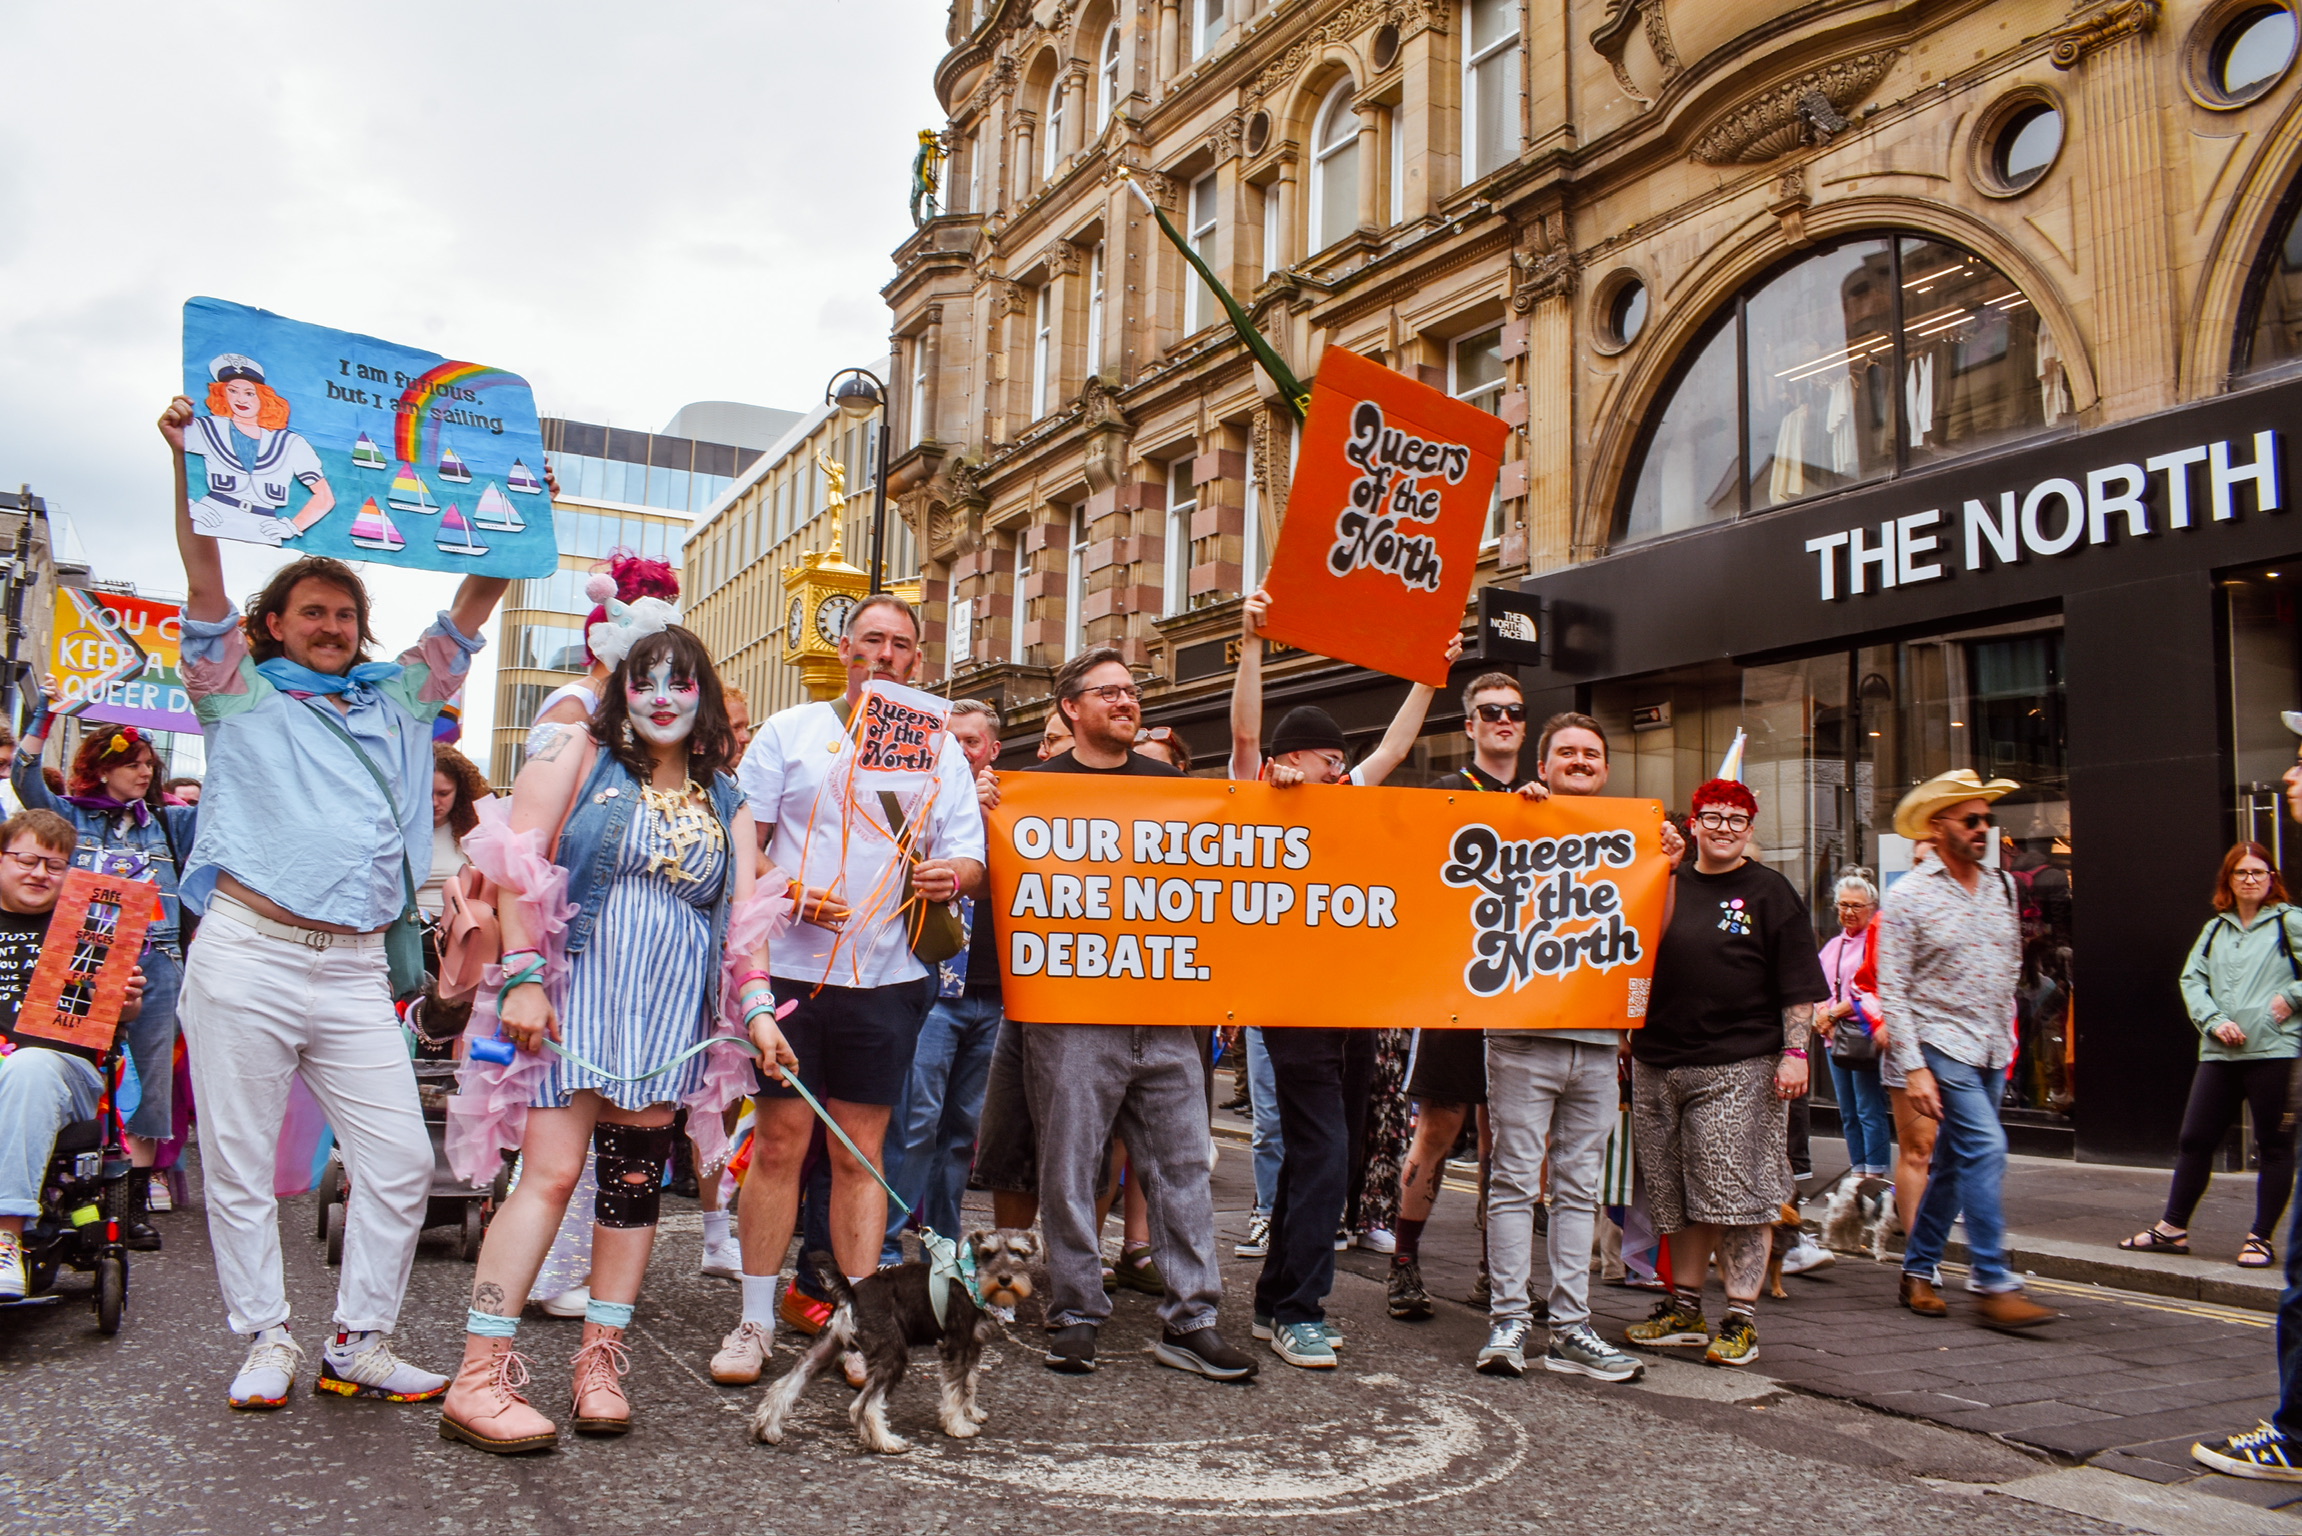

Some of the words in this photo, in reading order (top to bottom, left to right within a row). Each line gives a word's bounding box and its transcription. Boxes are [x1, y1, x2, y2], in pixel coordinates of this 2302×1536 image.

[339, 359, 350, 376] I
[357, 363, 388, 384] am
[325, 379, 369, 405] but
[373, 394, 383, 410] I
[390, 398, 422, 417] am
[430, 407, 504, 435] sailing
[1346, 402, 1470, 485] Queers
[1351, 466, 1393, 514] of
[1392, 478, 1440, 520] the
[1805, 508, 1946, 601] THE
[1963, 429, 2282, 571] NORTH
[1331, 509, 1441, 590] North
[73, 600, 148, 636] YOU
[1490, 618, 1521, 631] NORTH
[1498, 628, 1522, 640] FACE
[1503, 610, 1521, 622] THE
[59, 637, 136, 673] KEEP
[142, 652, 165, 679] A
[62, 674, 159, 711] QUEER
[866, 696, 940, 730] Queers
[869, 720, 891, 740] of
[895, 722, 924, 746] the
[861, 740, 934, 770] North
[1013, 816, 1122, 862] OUR
[1133, 820, 1311, 870] RIGHTS
[1441, 824, 1635, 892] Queers
[91, 887, 122, 902] SAFE
[1010, 872, 1111, 920] ARE
[1123, 875, 1223, 923] NOT
[1231, 880, 1296, 925] UP
[1305, 883, 1398, 928] FOR
[1472, 873, 1531, 932] of
[1534, 870, 1619, 921] the
[0, 931, 39, 942] JUST
[75, 930, 115, 945] SPACES
[1011, 931, 1211, 981] DEBATE.
[1465, 917, 1643, 996] North
[72, 973, 95, 982] FOR
[52, 1014, 82, 1028] ALL!
